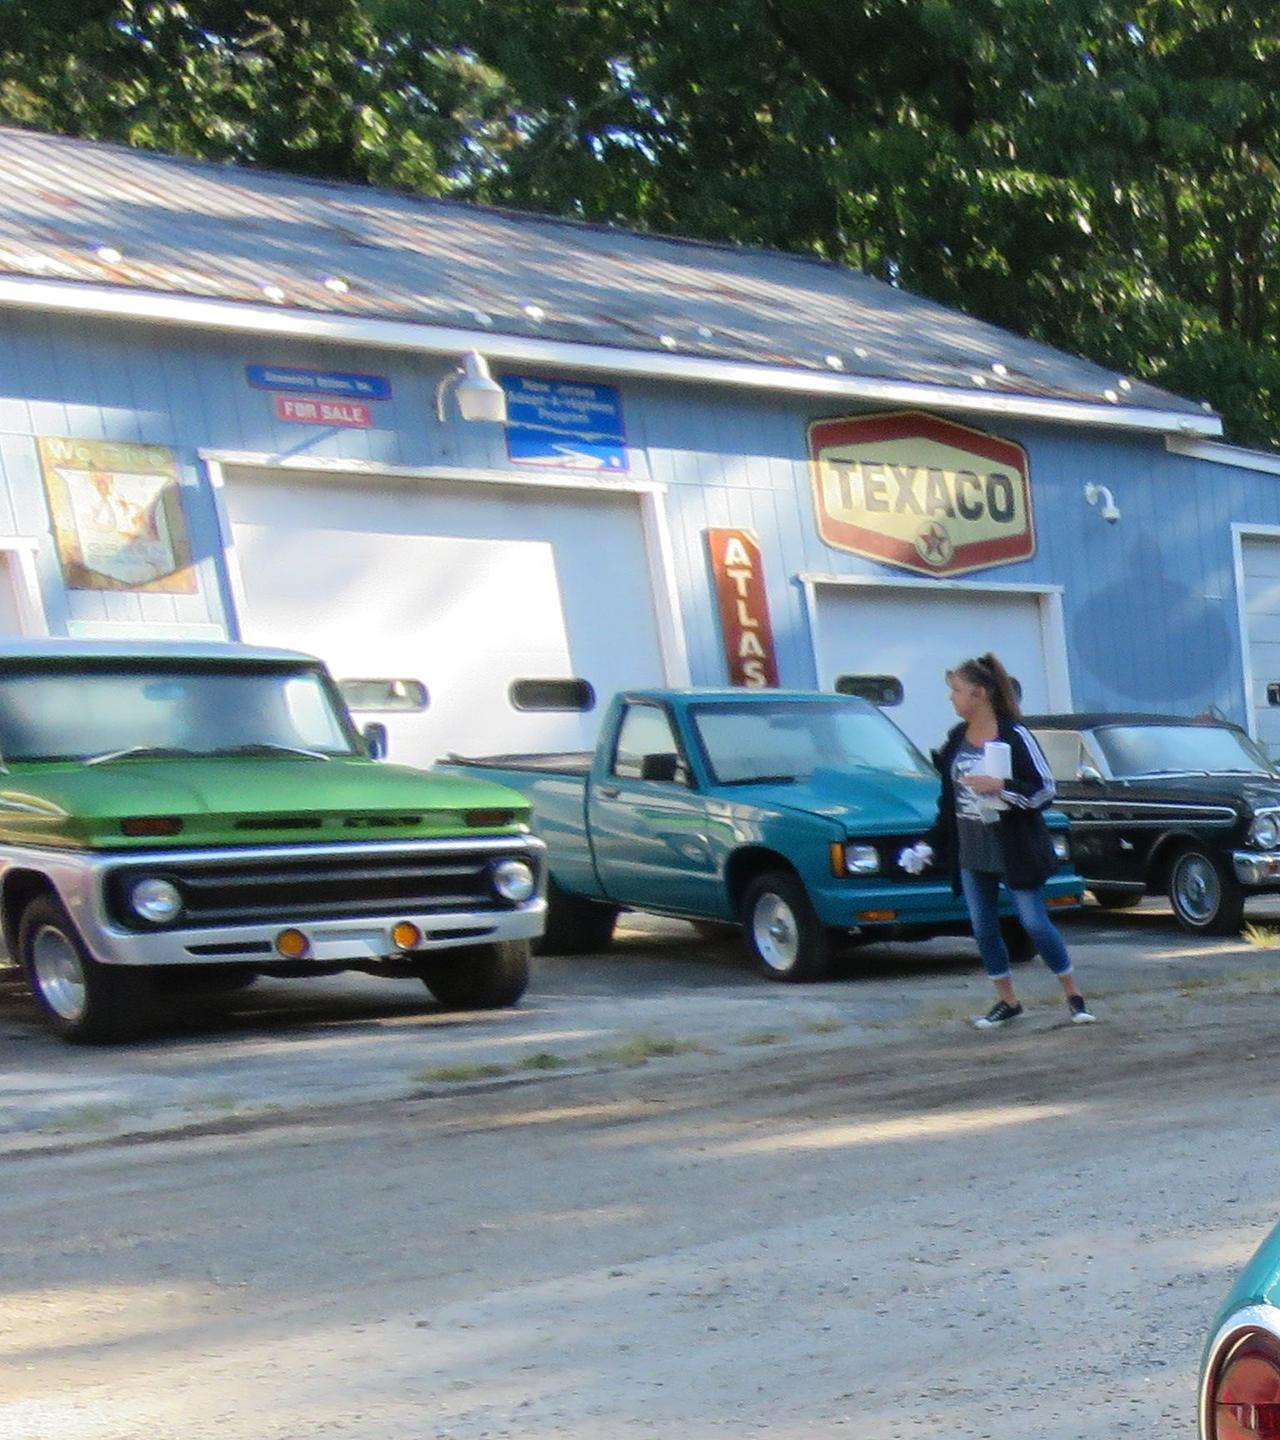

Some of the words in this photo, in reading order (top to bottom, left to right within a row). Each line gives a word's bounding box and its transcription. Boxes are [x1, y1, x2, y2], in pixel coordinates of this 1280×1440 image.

[283, 400, 317, 418] FOR
[320, 403, 365, 422] SALE
[828, 457, 1015, 522] TEXACO
[724, 538, 766, 688] ATLAS
